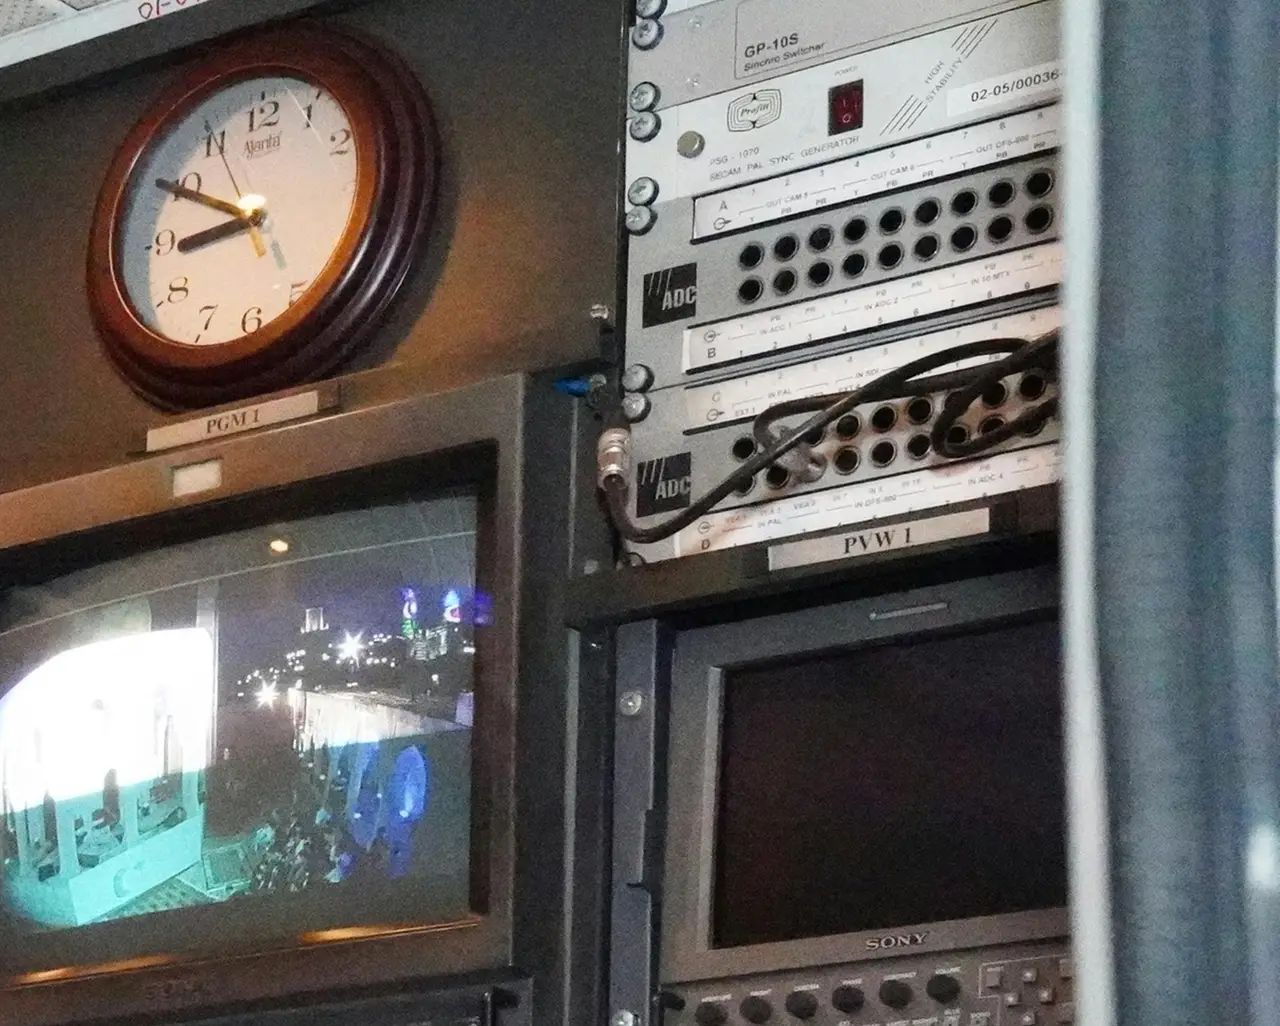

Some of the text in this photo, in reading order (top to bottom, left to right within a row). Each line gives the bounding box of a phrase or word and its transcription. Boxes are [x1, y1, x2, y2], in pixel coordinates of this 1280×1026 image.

[744, 32, 800, 59] GP-10S
[924, 60, 946, 85] HIGH
[926, 57, 964, 104] STABILITY
[970, 68, 1063, 102] 02-05/00036
[247, 100, 280, 133] 12
[303, 103, 313, 129] 1
[202, 130, 228, 158] 11
[330, 128, 351, 156] 2
[769, 152, 795, 166] SYNC
[800, 135, 860, 158] GENERATOR
[718, 200, 729, 211] A
[154, 228, 176, 257] 9
[167, 276, 189, 304] 8
[662, 285, 698, 311] ADC
[199, 304, 218, 331] 7
[241, 306, 263, 334] 6
[707, 347, 717, 359] B
[206, 409, 261, 434] PGM 1
[655, 475, 691, 500] ADC
[843, 526, 912, 555] PVW 1
[866, 931, 929, 951] SONY
